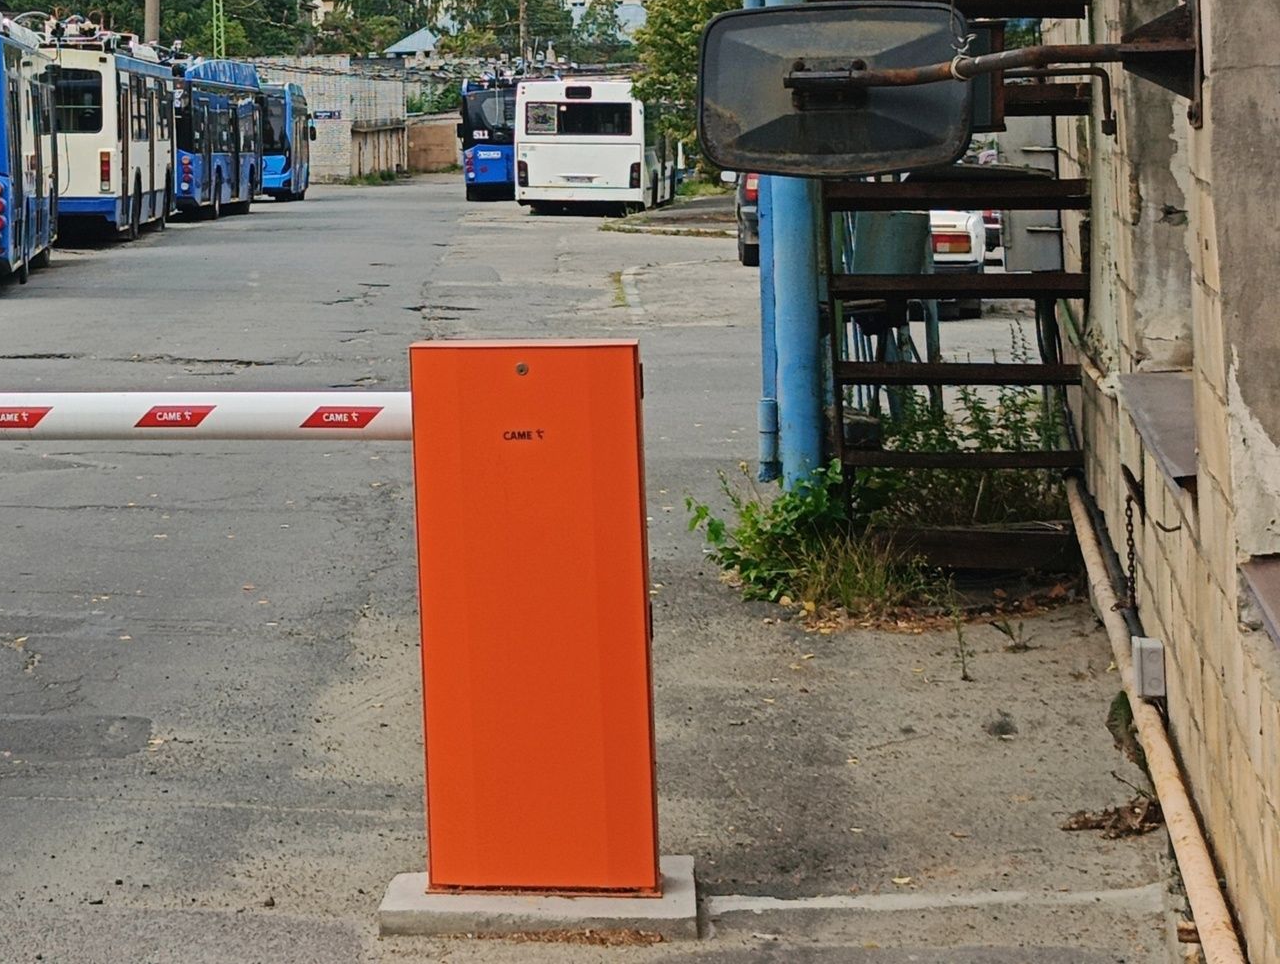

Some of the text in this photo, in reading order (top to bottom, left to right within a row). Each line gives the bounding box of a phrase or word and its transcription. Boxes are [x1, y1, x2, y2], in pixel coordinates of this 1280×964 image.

[473, 130, 489, 139] 511
[156, 412, 182, 421] CAME
[322, 412, 348, 422] CAME
[503, 431, 533, 440] CAME
